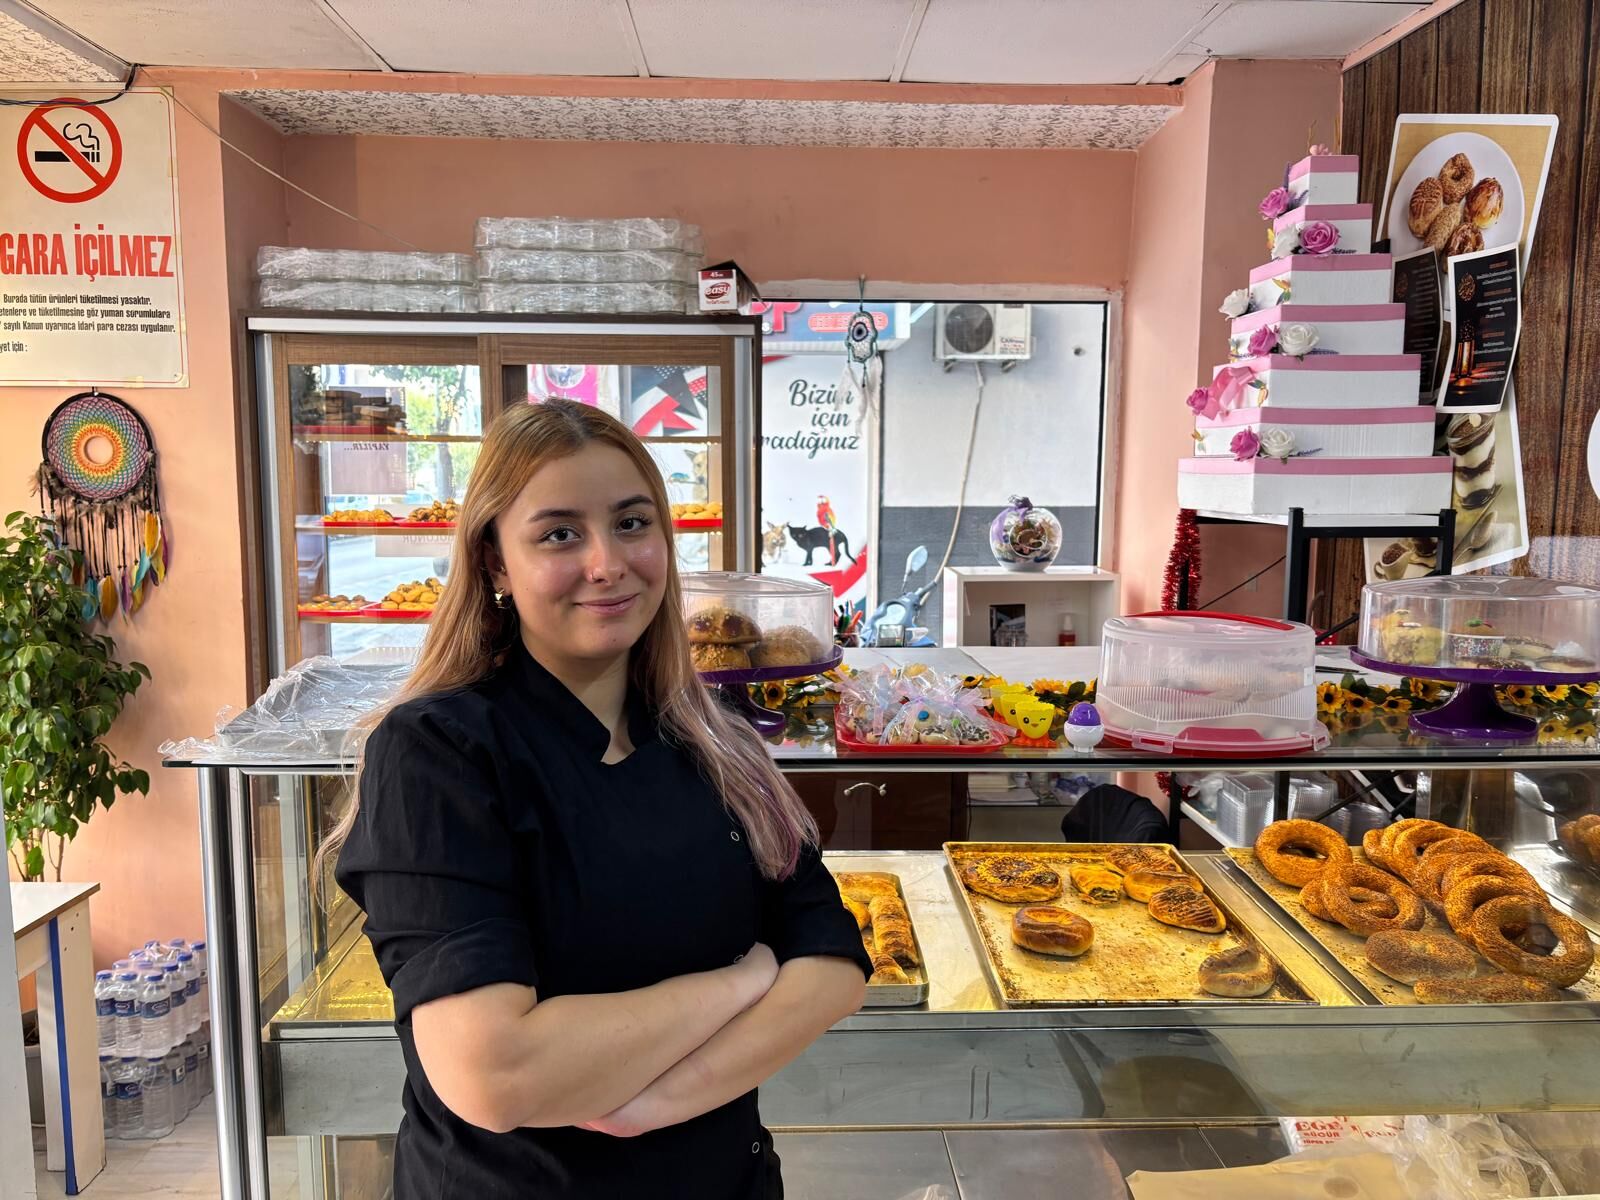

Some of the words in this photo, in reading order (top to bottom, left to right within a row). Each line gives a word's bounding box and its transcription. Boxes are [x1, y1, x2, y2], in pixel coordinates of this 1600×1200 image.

[0, 233, 68, 275] GARA
[74, 223, 174, 282] İÇİLMEZ
[705, 285, 730, 296] easy
[3, 294, 28, 304] Burada
[30, 294, 47, 303] tütün
[49, 294, 78, 304] ürünleri
[80, 295, 119, 304] tüketilmesi
[120, 296, 152, 306] yasaktır.
[29, 309, 37, 317] ve
[39, 307, 85, 317] tüketilmesine
[87, 308, 98, 319] göz
[100, 309, 124, 319] yuman
[126, 309, 171, 319] sorumlulara
[4, 321, 21, 331] sayılı
[23, 321, 43, 331] Kanun
[45, 322, 76, 332] uyarınca
[78, 321, 95, 331] idari
[97, 323, 114, 332] para
[116, 323, 139, 332] cezası
[141, 323, 176, 334] uygulanır.
[12, 341, 24, 353] için
[811, 407, 850, 433] için
